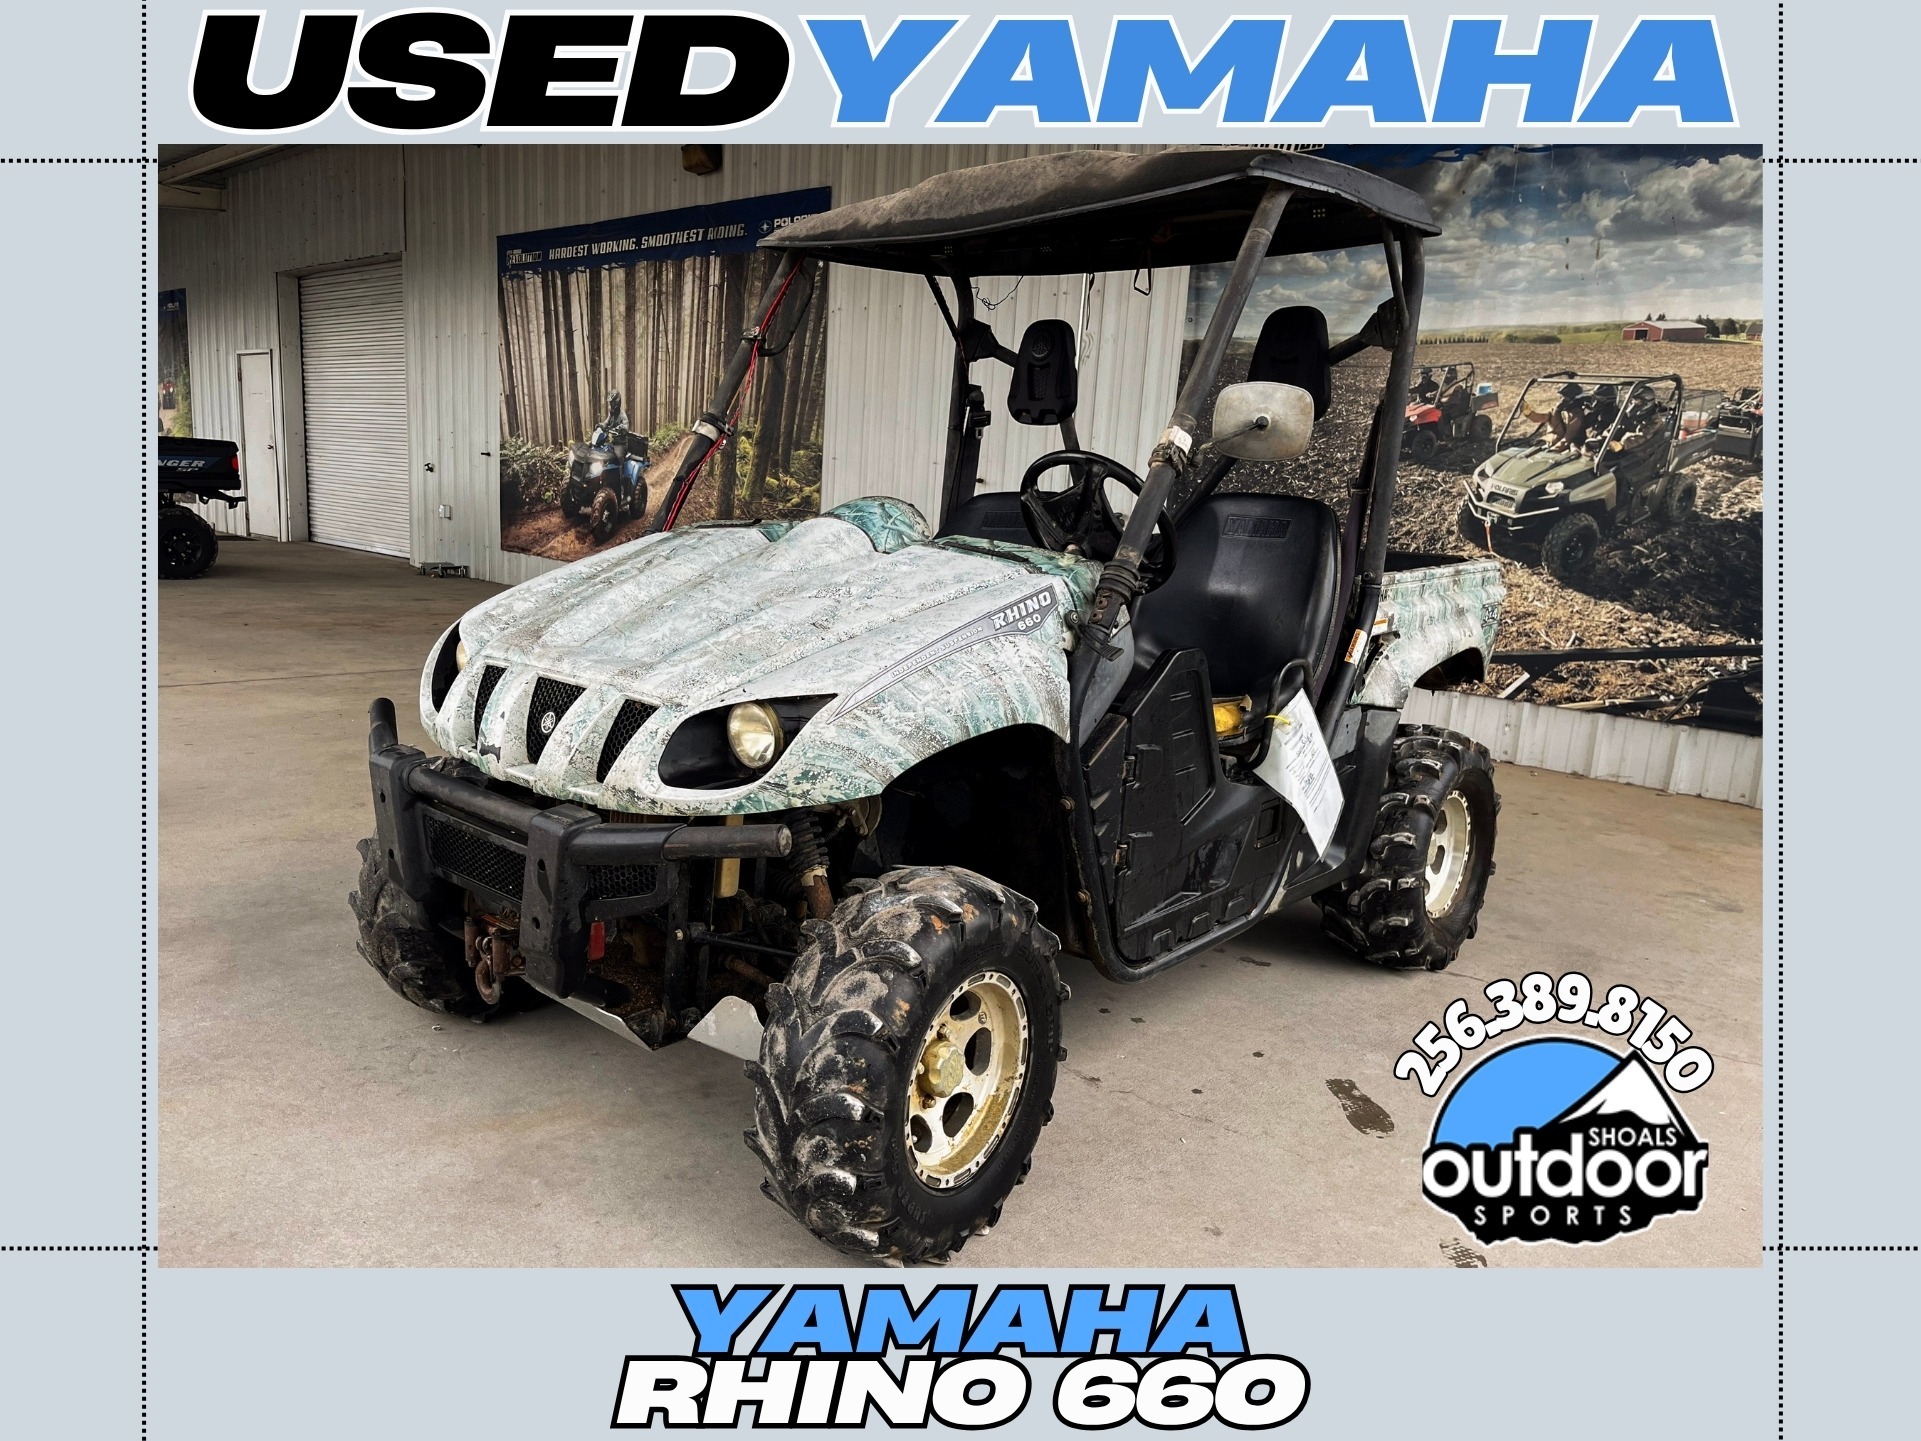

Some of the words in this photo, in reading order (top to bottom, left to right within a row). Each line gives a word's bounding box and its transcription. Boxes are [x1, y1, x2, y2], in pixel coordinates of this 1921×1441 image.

[549, 244, 589, 260] HARDEST
[592, 237, 639, 255] WORKING.
[640, 228, 705, 249] SMOOTHEST
[989, 591, 1052, 631] RHINO
[1017, 613, 1042, 631] 660
[891, 647, 940, 678] INDEPENDENT
[940, 626, 983, 651] SUSPENSION
